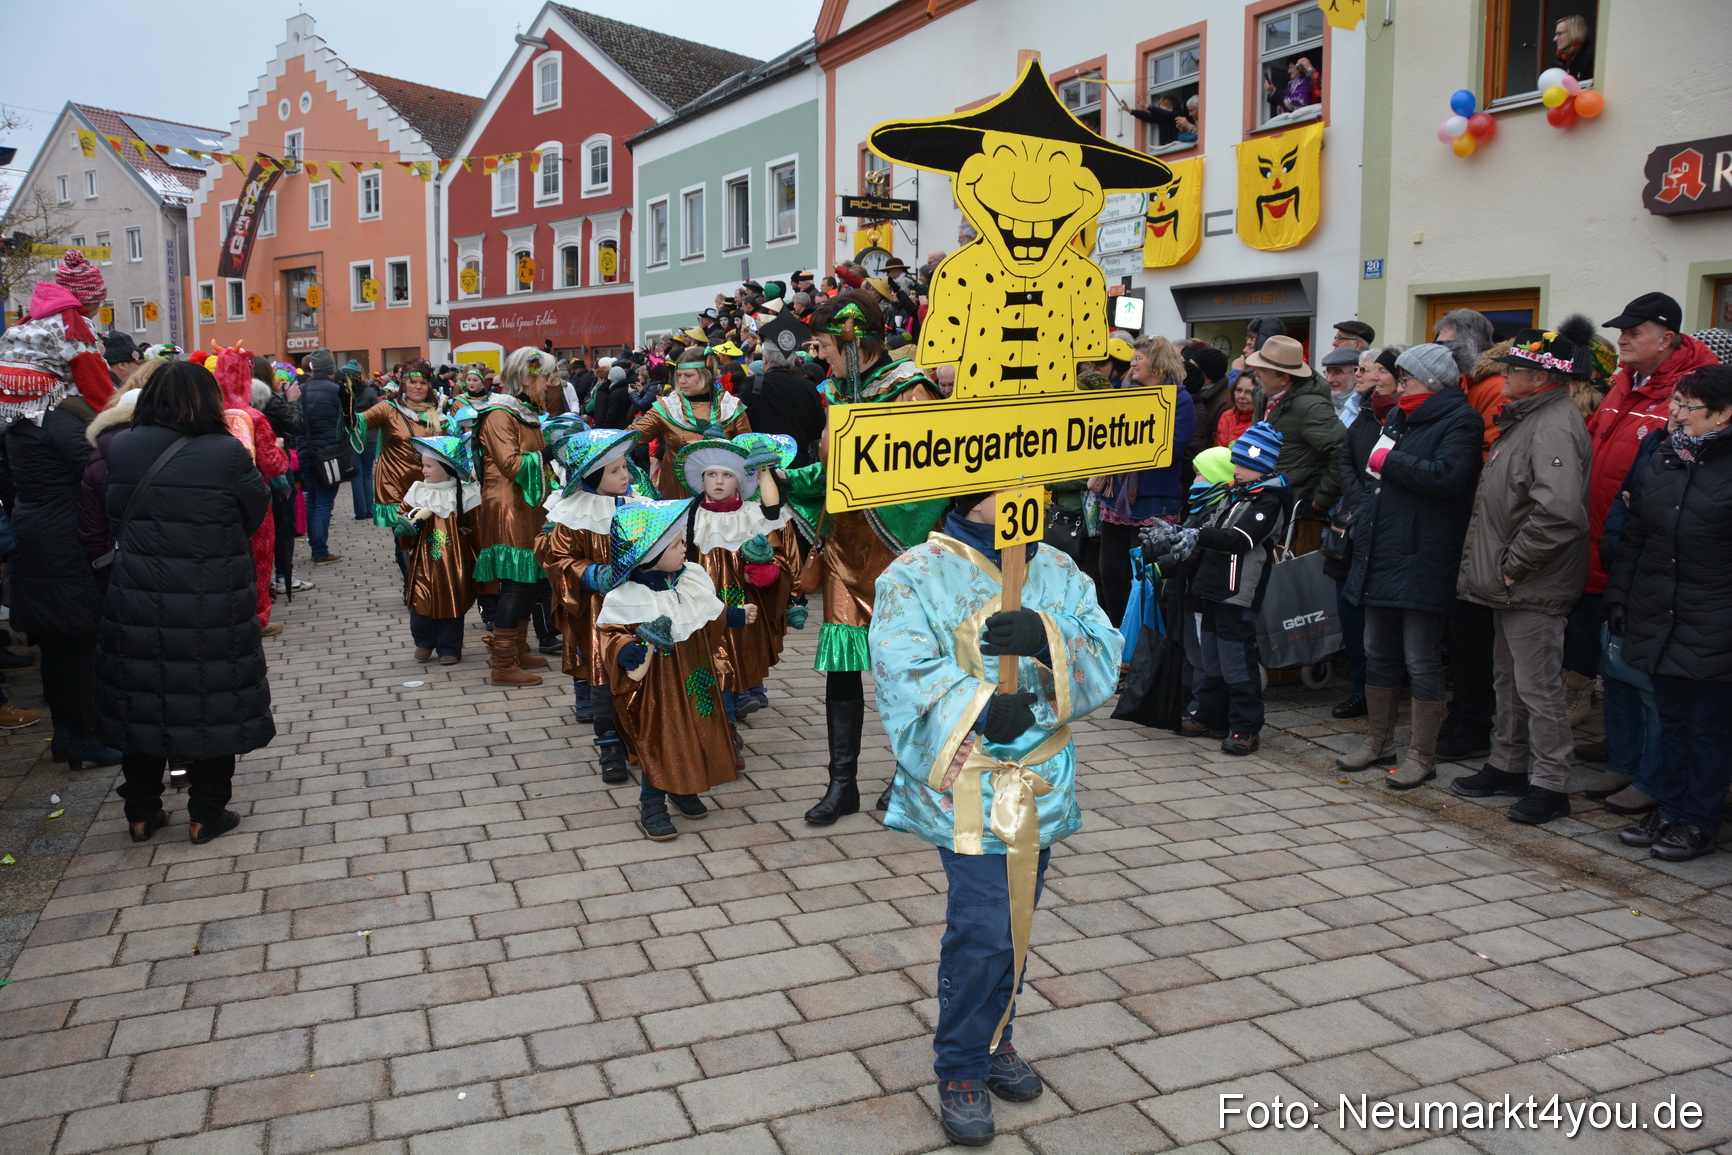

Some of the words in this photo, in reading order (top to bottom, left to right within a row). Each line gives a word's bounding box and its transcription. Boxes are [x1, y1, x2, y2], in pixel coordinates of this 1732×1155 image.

[850, 200, 910, 211] RÖHLICH
[167, 240, 175, 283] UHREN
[1366, 260, 1380, 272] 20
[1230, 290, 1286, 305] UHREN
[429, 317, 447, 327] CAFÉ
[287, 337, 319, 348] GÖTZ
[853, 424, 1057, 475] Kindergarten
[1066, 413, 1156, 453] Dietfurt
[1001, 498, 1040, 540] 30
